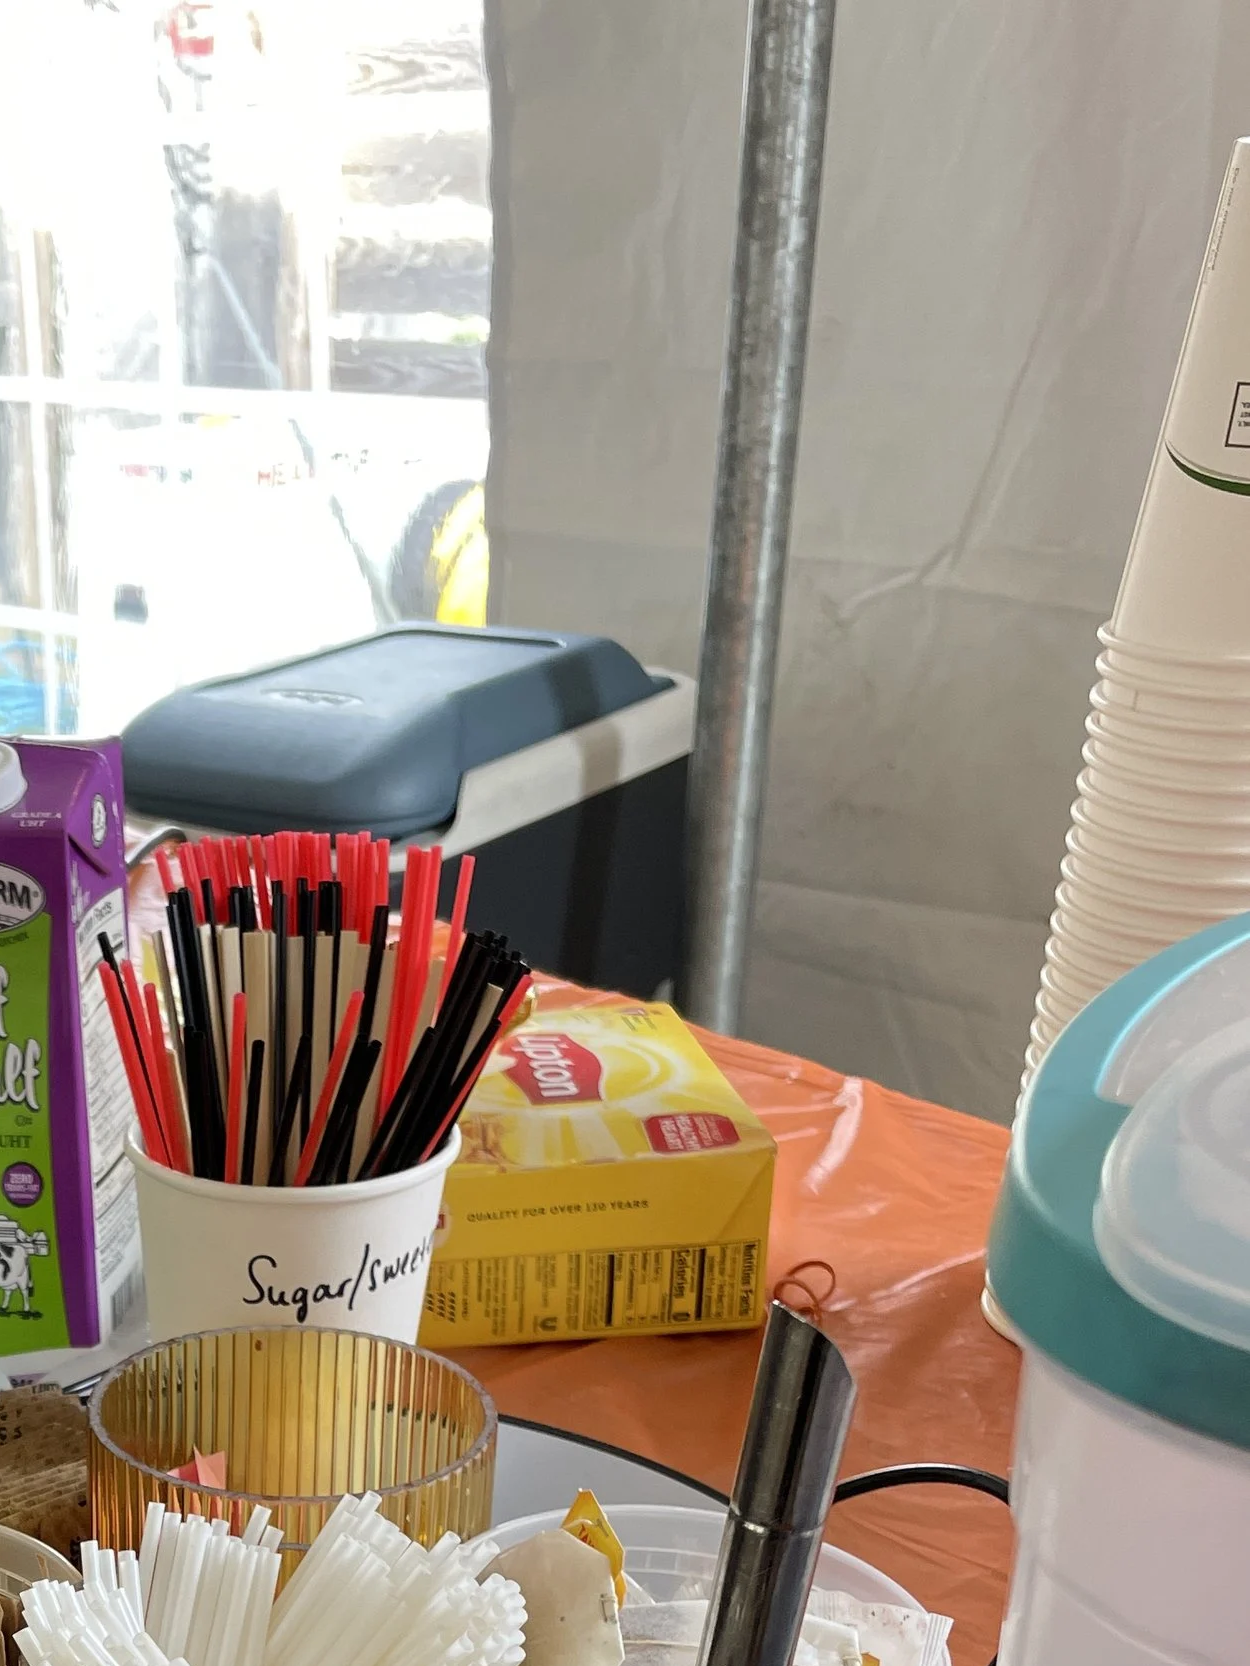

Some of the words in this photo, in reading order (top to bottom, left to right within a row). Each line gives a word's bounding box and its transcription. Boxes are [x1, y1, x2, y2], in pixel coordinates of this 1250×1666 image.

[511, 1034, 581, 1098] Lipton
[467, 1210, 518, 1222] QUALITY
[522, 1207, 546, 1218] FOR
[550, 1205, 582, 1215] OVER
[611, 1200, 650, 1211] YEARS
